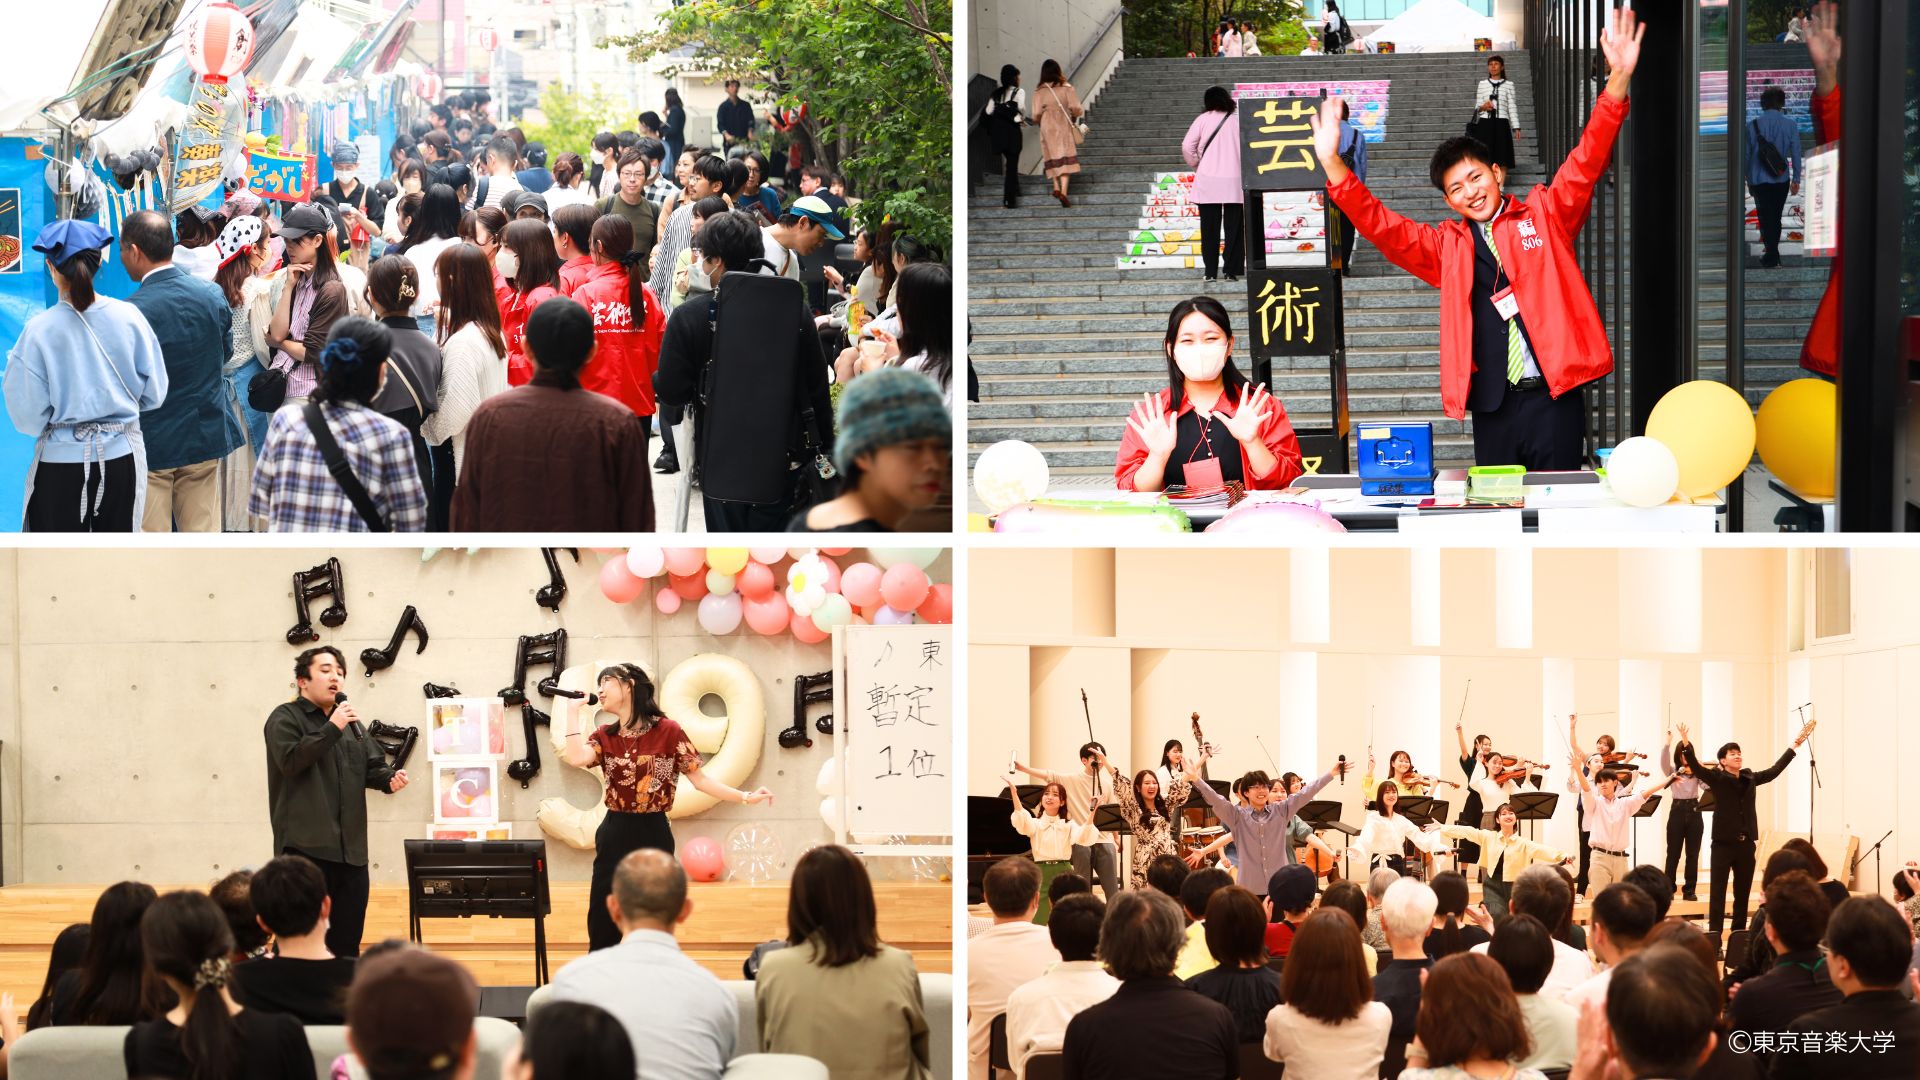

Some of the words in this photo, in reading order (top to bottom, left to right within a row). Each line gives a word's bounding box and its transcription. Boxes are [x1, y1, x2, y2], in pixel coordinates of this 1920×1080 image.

[244, 163, 304, 198] だがし
[1521, 234, 1543, 251] 806
[919, 639, 943, 671] 東
[866, 682, 941, 728] 暫定
[875, 745, 945, 780] 1位
[450, 778, 479, 809] C
